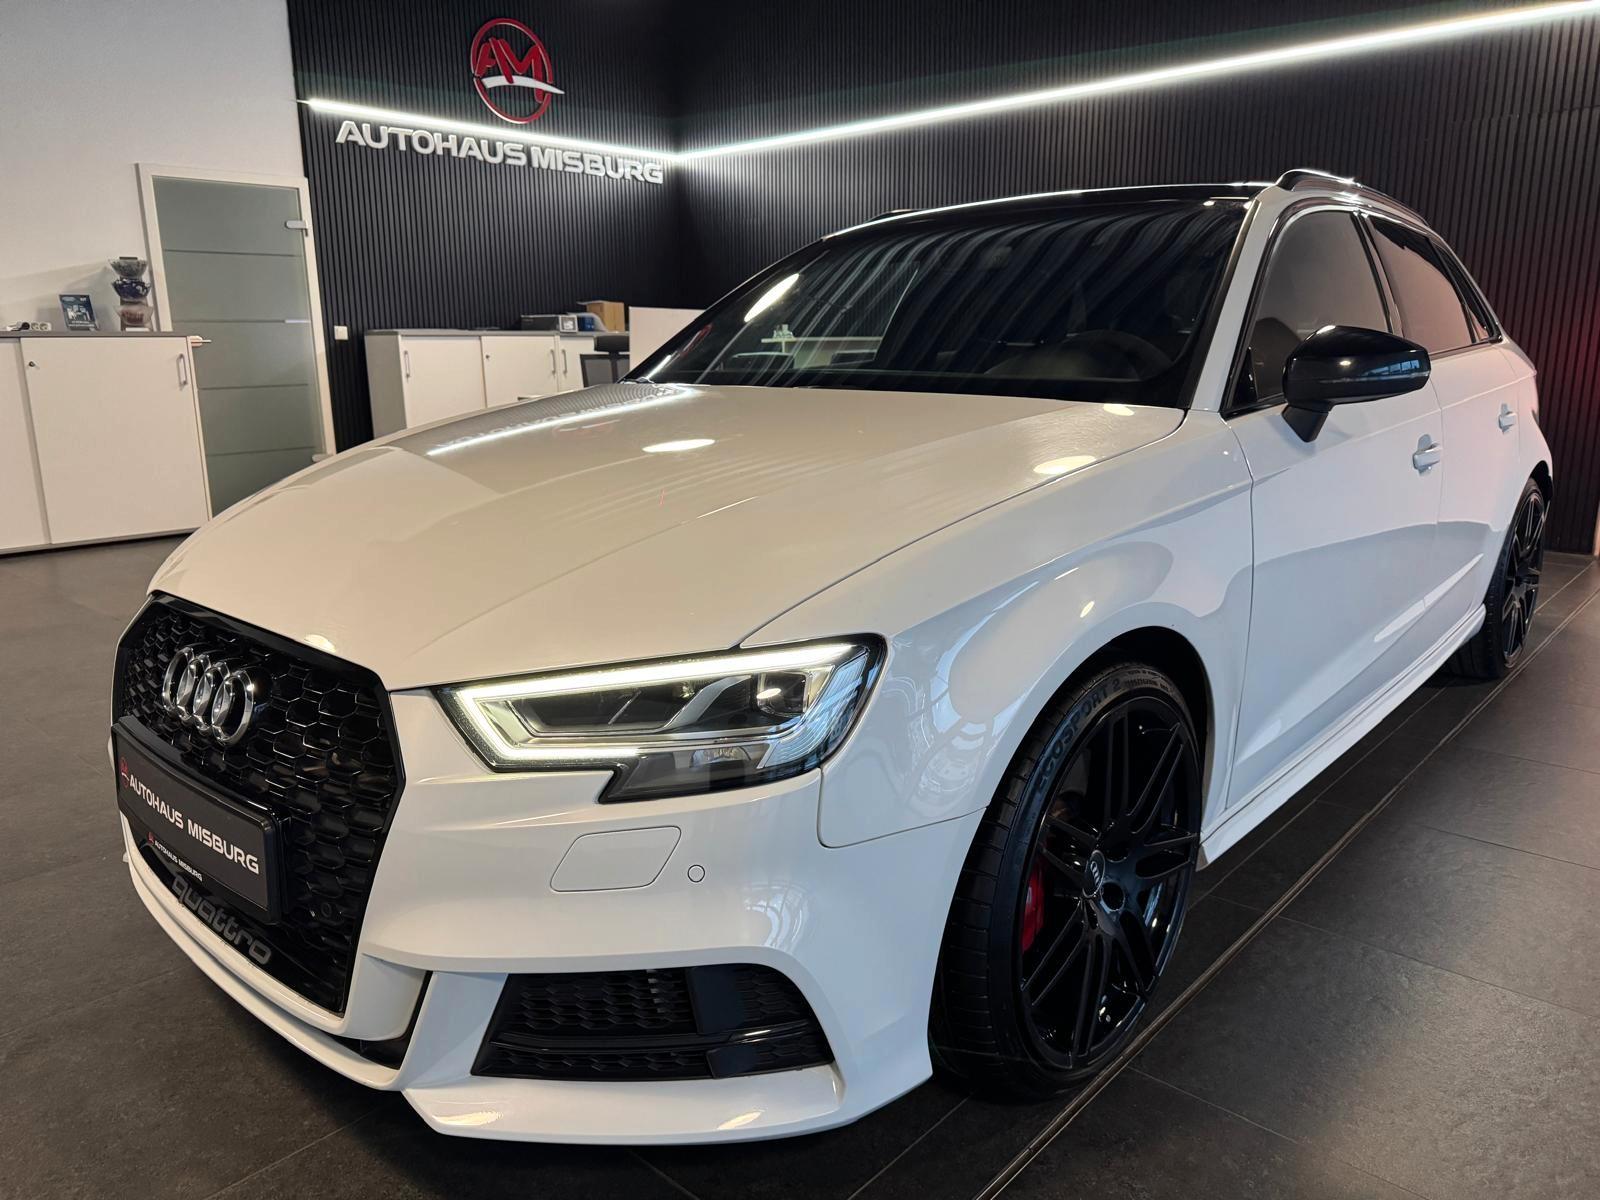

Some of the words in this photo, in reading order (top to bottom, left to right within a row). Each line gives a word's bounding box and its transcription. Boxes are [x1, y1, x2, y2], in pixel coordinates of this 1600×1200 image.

[476, 37, 544, 104] AM
[335, 120, 527, 166] AUTOHAUS
[531, 146, 663, 184] MISBURG
[130, 774, 184, 828] AUTOHAUS
[188, 819, 259, 874] MISBURG
[154, 840, 178, 863] AUTOHAUS
[178, 859, 202, 882] MISBURG
[172, 876, 271, 965] quattro
